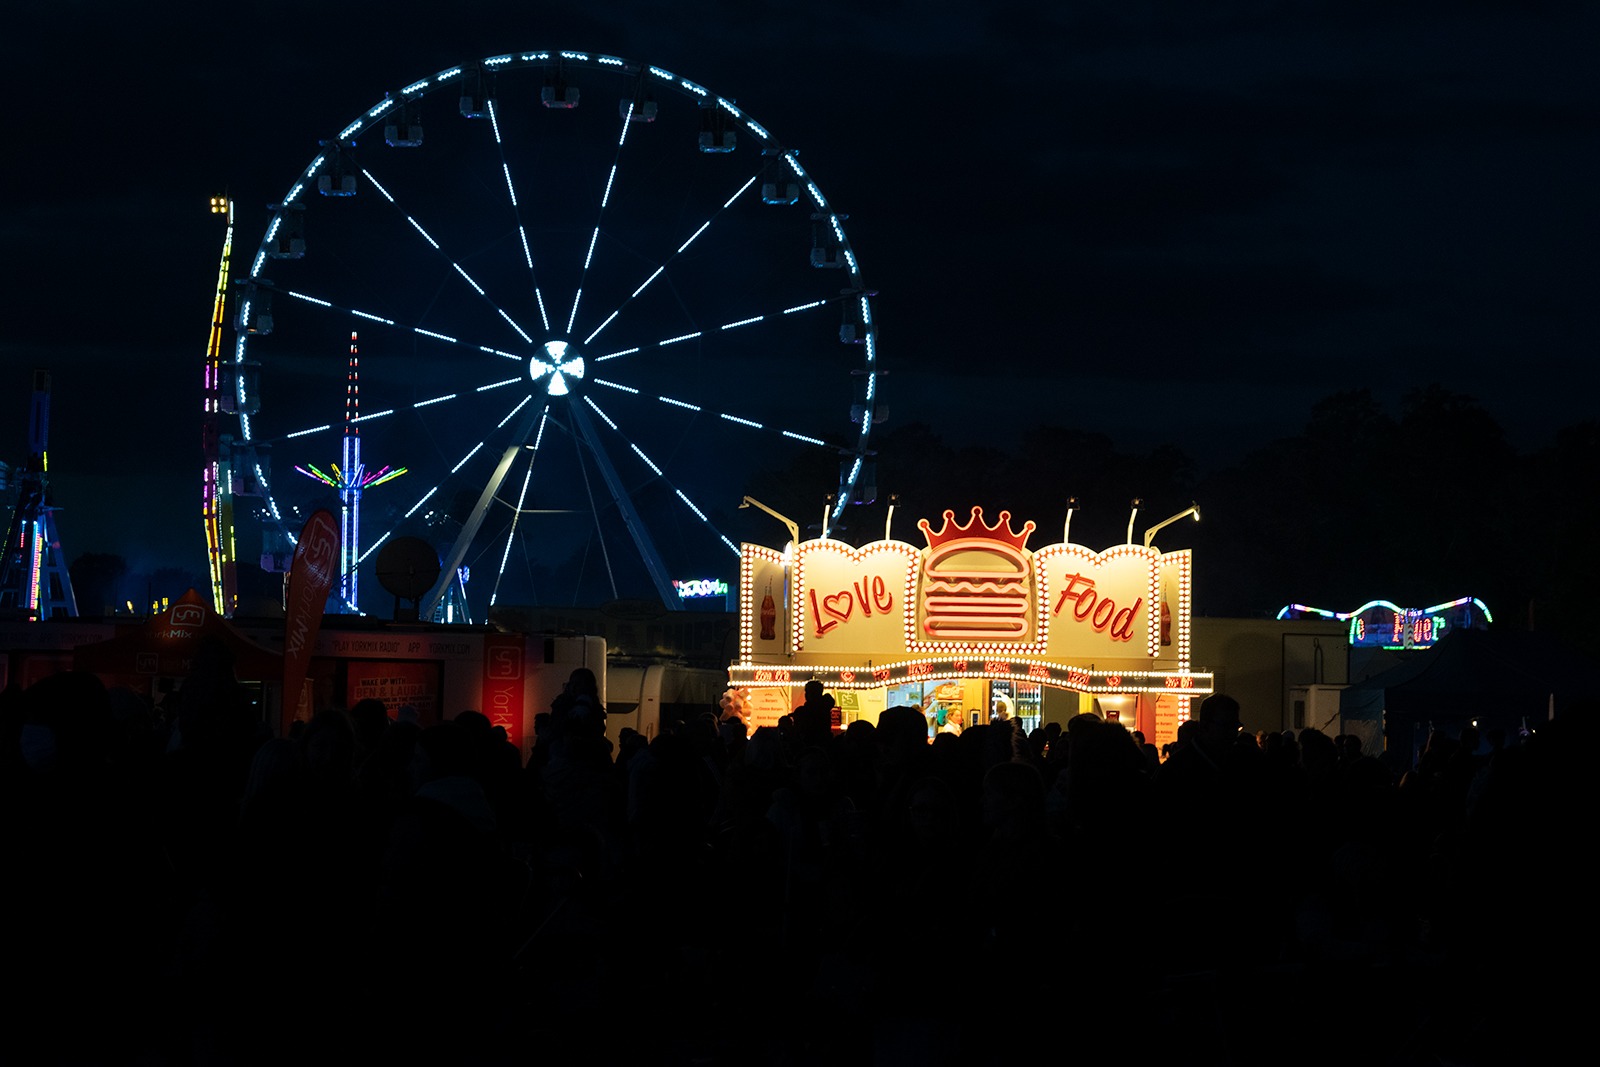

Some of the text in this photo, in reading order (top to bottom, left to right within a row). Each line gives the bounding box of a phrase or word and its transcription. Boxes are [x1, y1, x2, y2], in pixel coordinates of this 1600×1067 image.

[1053, 572, 1142, 642] Food
[408, 642, 421, 653] APP
[361, 678, 378, 686] WAKE
[390, 677, 406, 685] WITH
[356, 687, 376, 697] BEN
[390, 685, 424, 696] LAURA
[493, 685, 515, 740] YorkM
